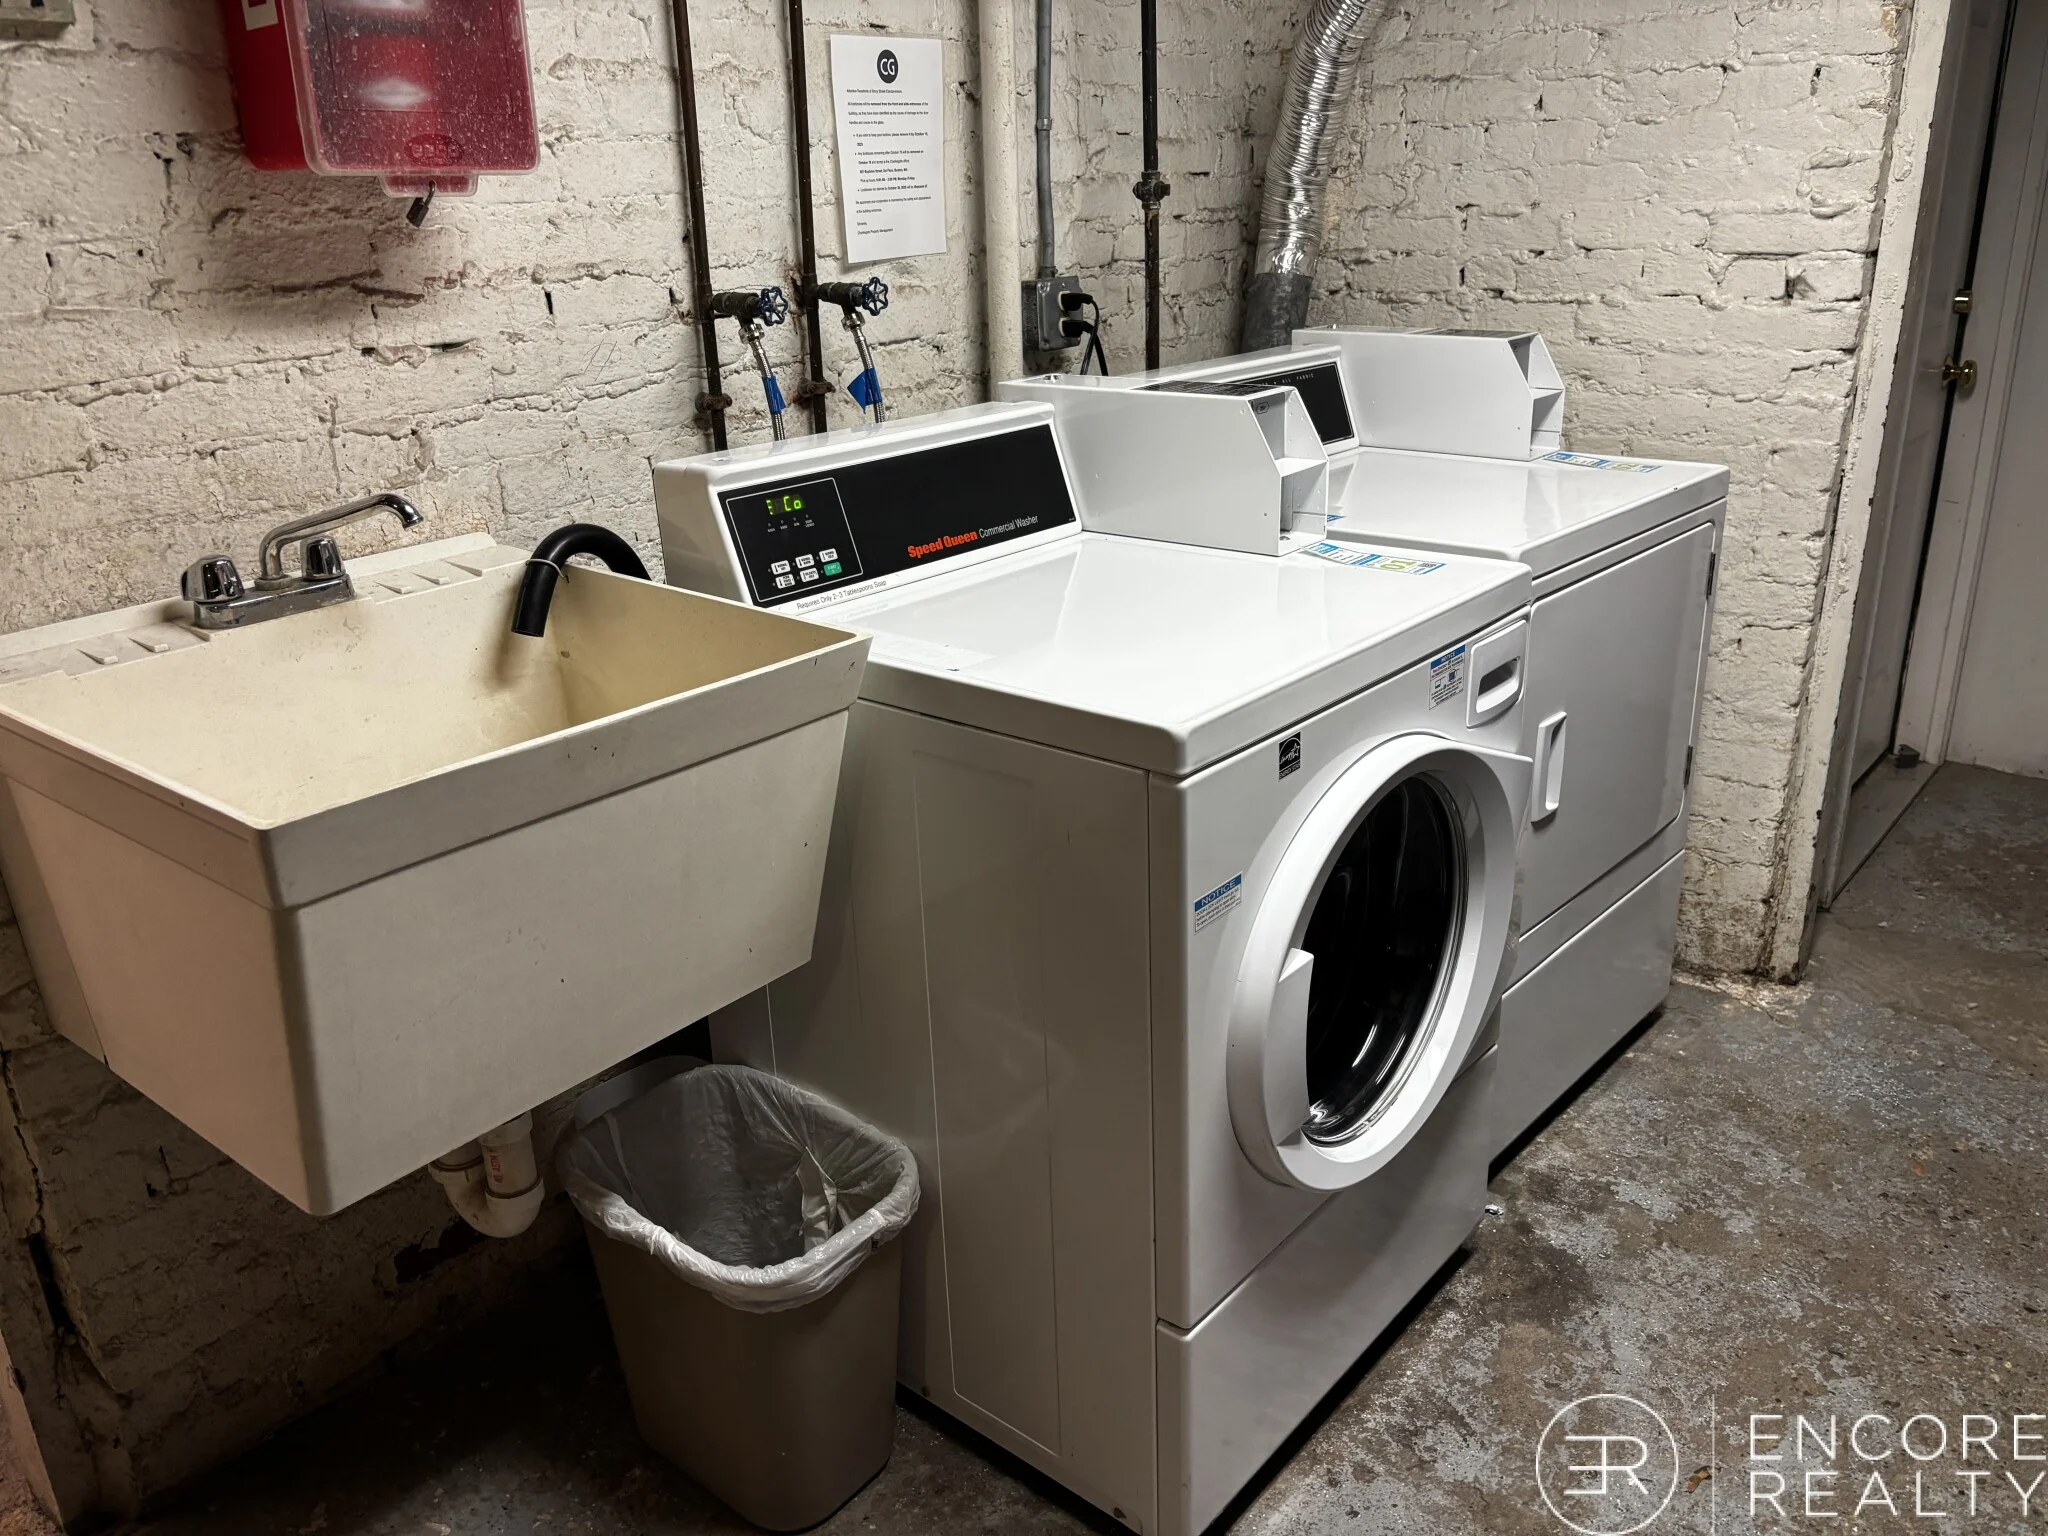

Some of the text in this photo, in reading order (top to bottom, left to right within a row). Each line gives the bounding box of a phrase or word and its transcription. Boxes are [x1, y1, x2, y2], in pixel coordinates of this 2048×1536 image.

[880, 58, 896, 76] CG
[907, 515, 1038, 558] Speed Queen Commercial Washer
[797, 580, 887, 609] Requires Only 2-3 Tablespoons Soap
[1441, 651, 1456, 661] NOTICE
[1201, 879, 1236, 906] NOTICE
